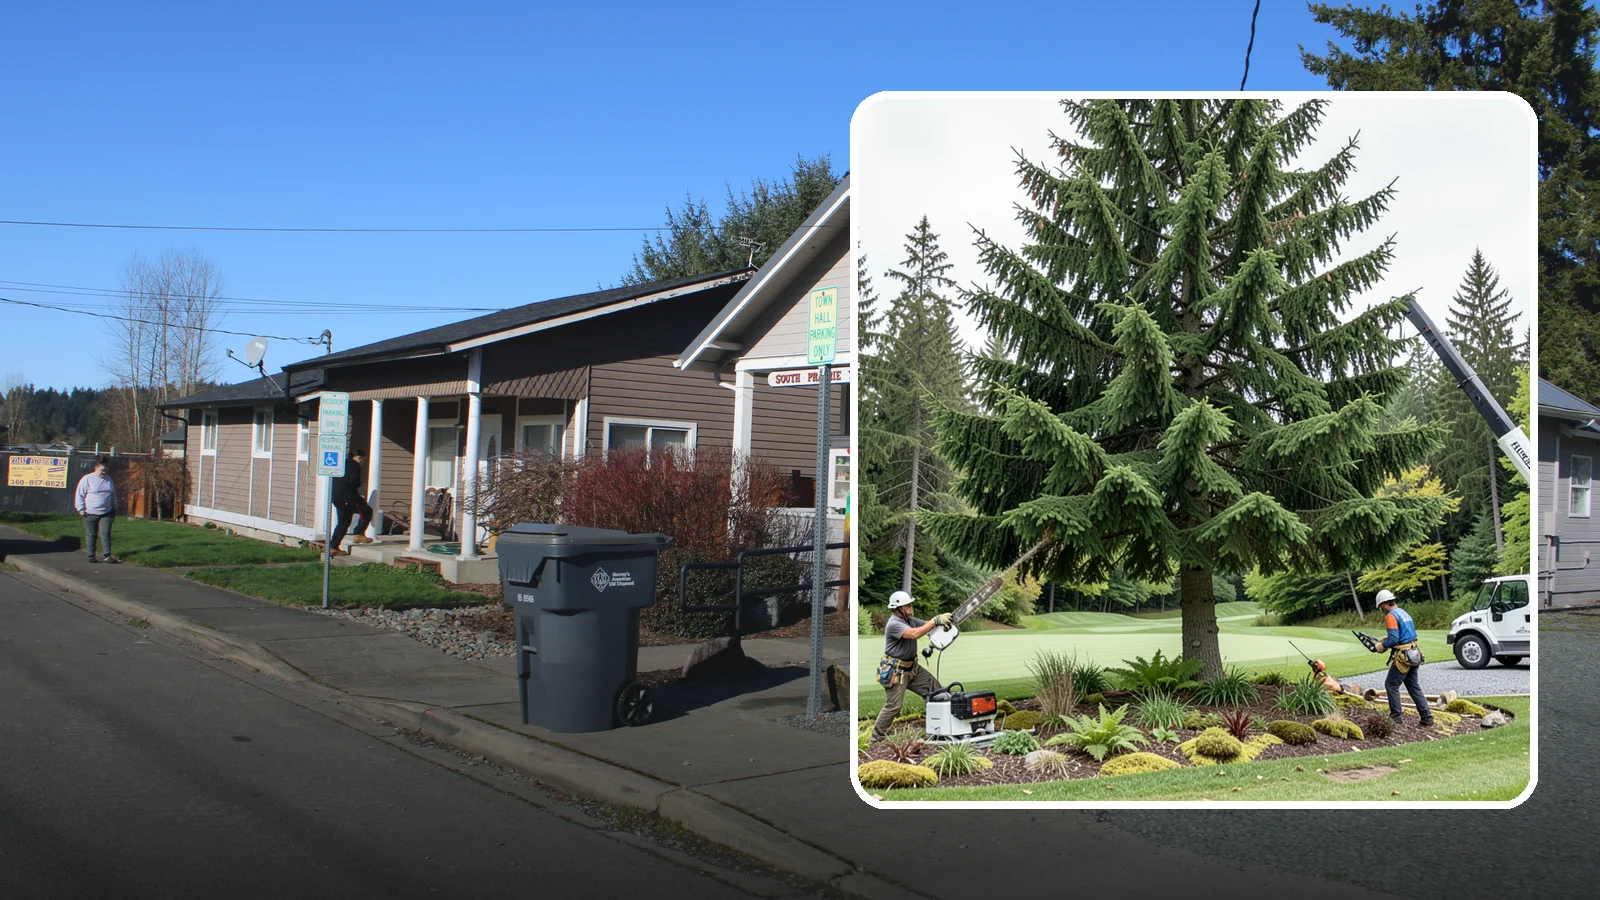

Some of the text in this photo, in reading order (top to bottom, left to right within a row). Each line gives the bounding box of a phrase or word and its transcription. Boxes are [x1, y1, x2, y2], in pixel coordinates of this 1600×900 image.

[815, 295, 832, 308] TOWN
[814, 312, 831, 324] HALL
[810, 326, 835, 341] PARKING
[814, 344, 830, 357] ONLY
[775, 373, 801, 384] SOUTH
[807, 371, 842, 382] PRIE
[323, 409, 344, 417] PARKING
[320, 436, 344, 444] RESERVED
